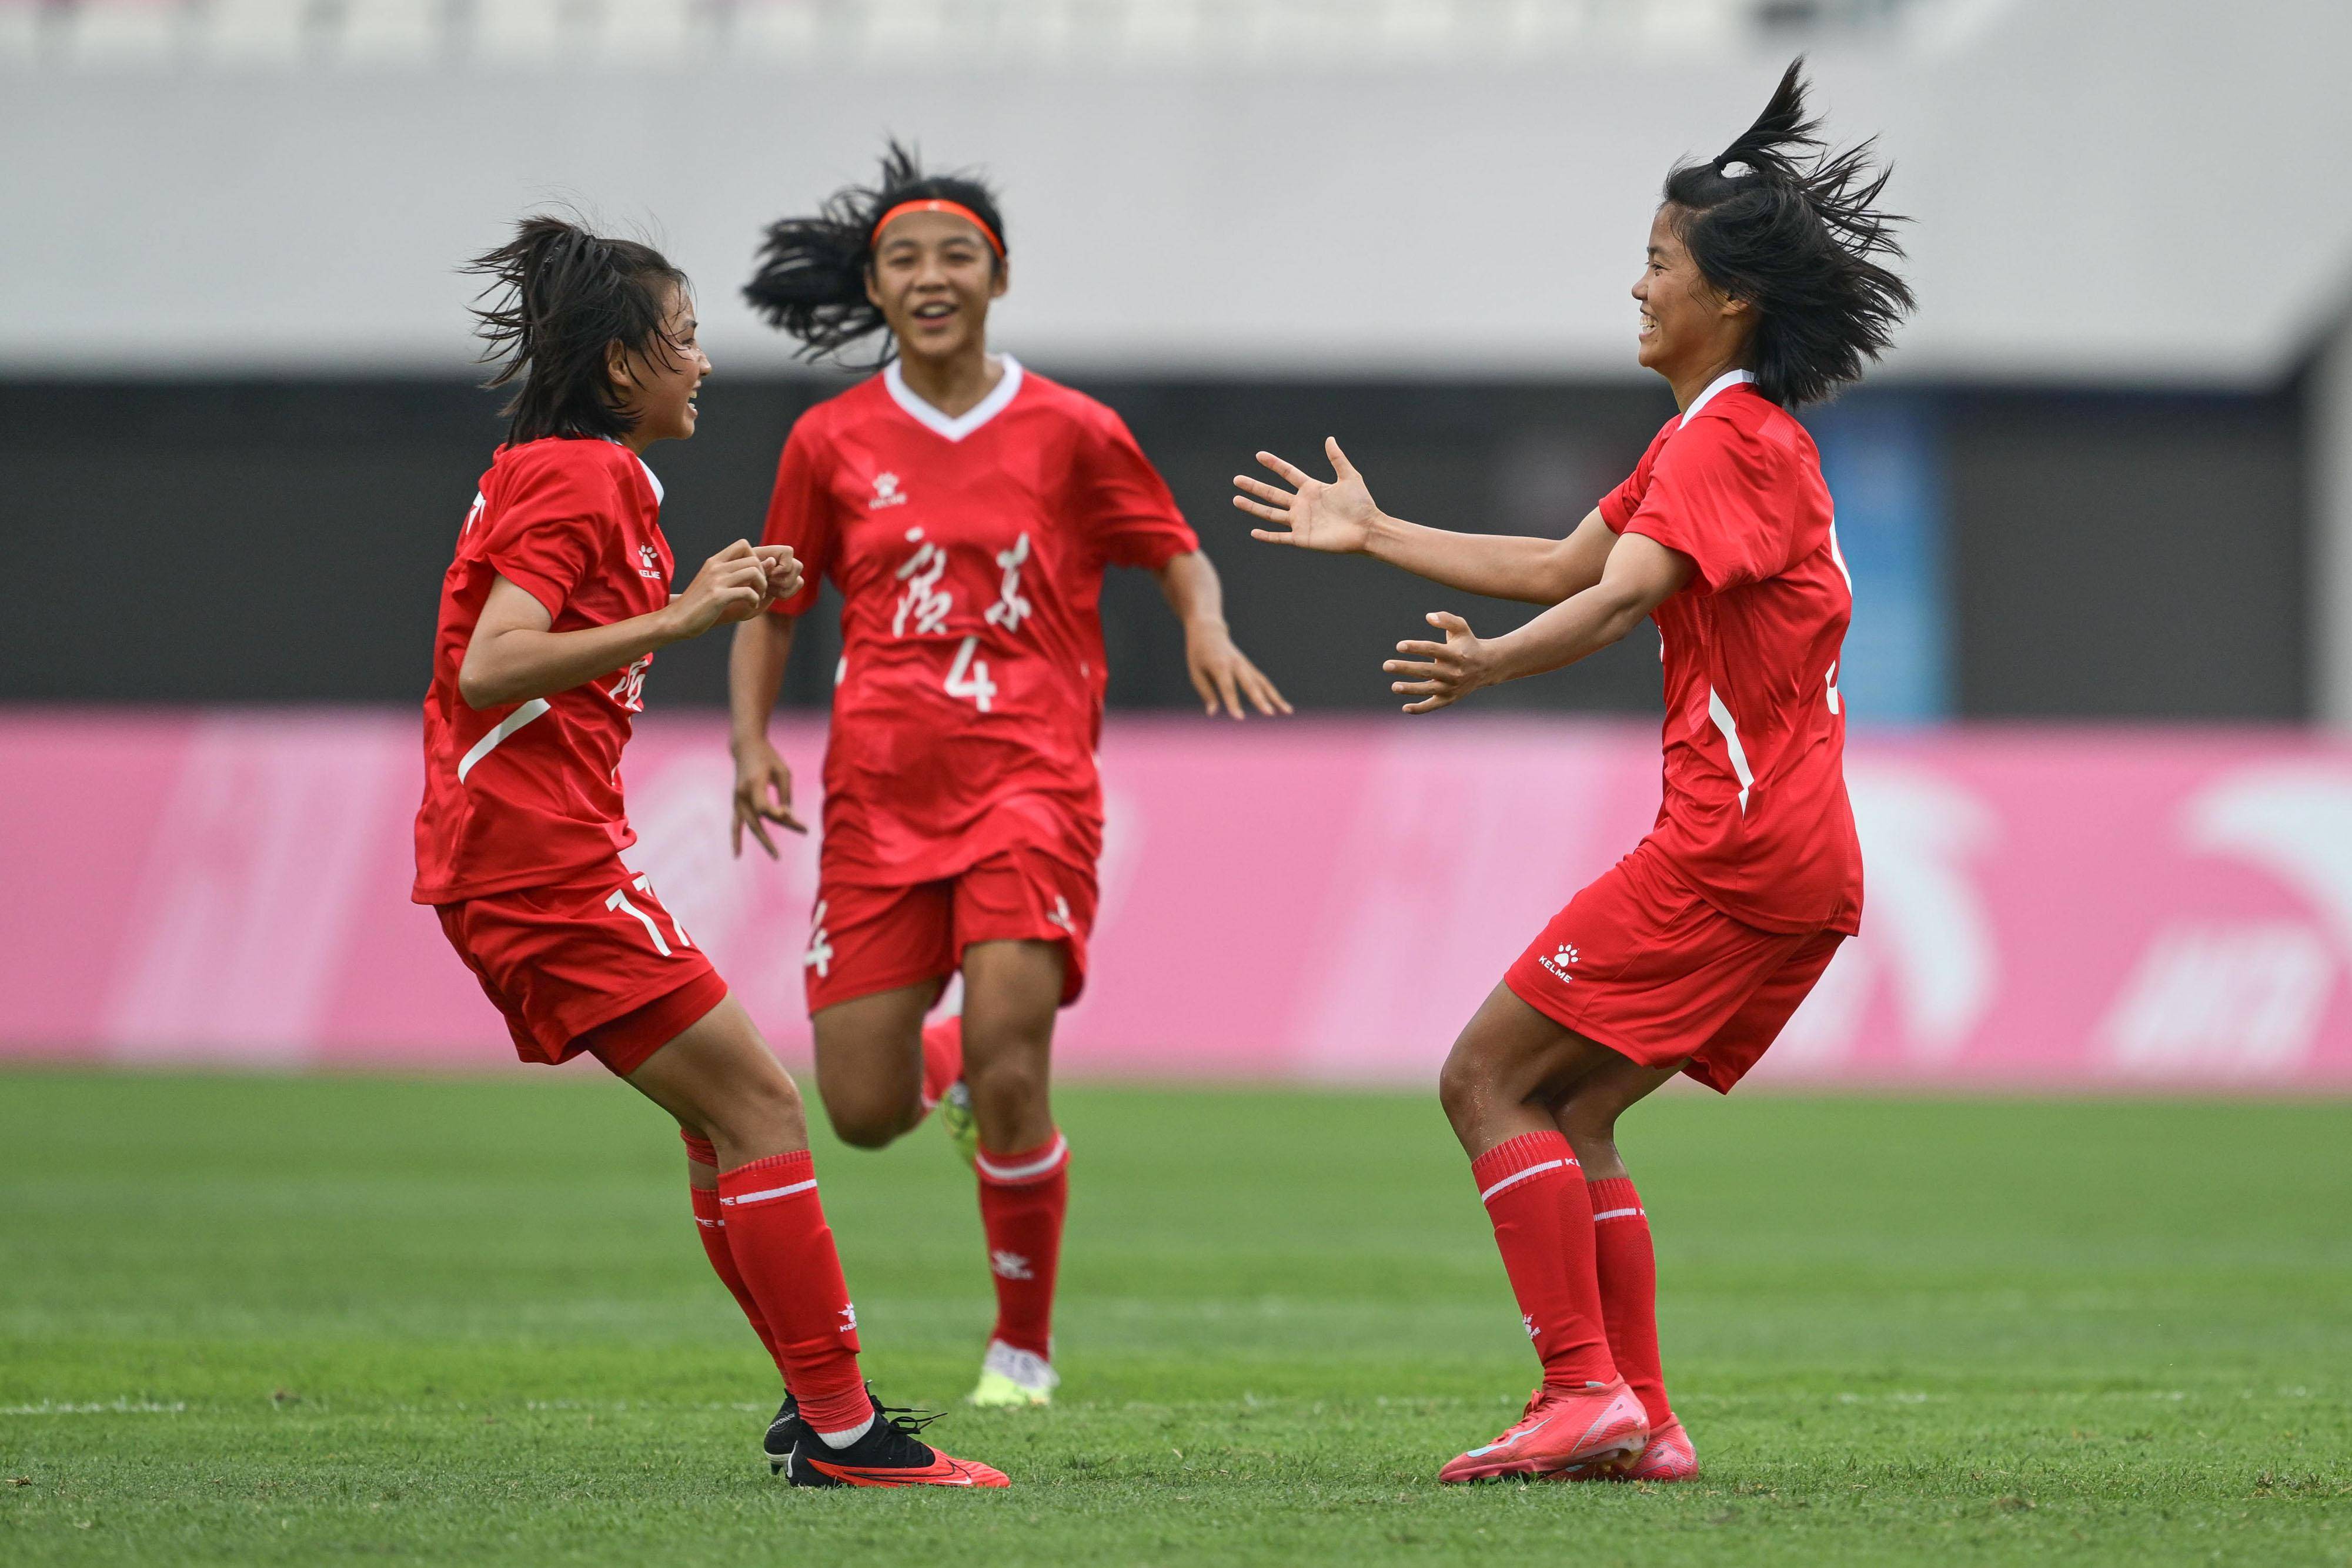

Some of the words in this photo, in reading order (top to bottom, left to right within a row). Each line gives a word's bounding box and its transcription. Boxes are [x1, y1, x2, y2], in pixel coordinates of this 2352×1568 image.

[944, 637, 997, 712] 4
[803, 900, 834, 977] 4
[1538, 955, 1573, 984] KELME
